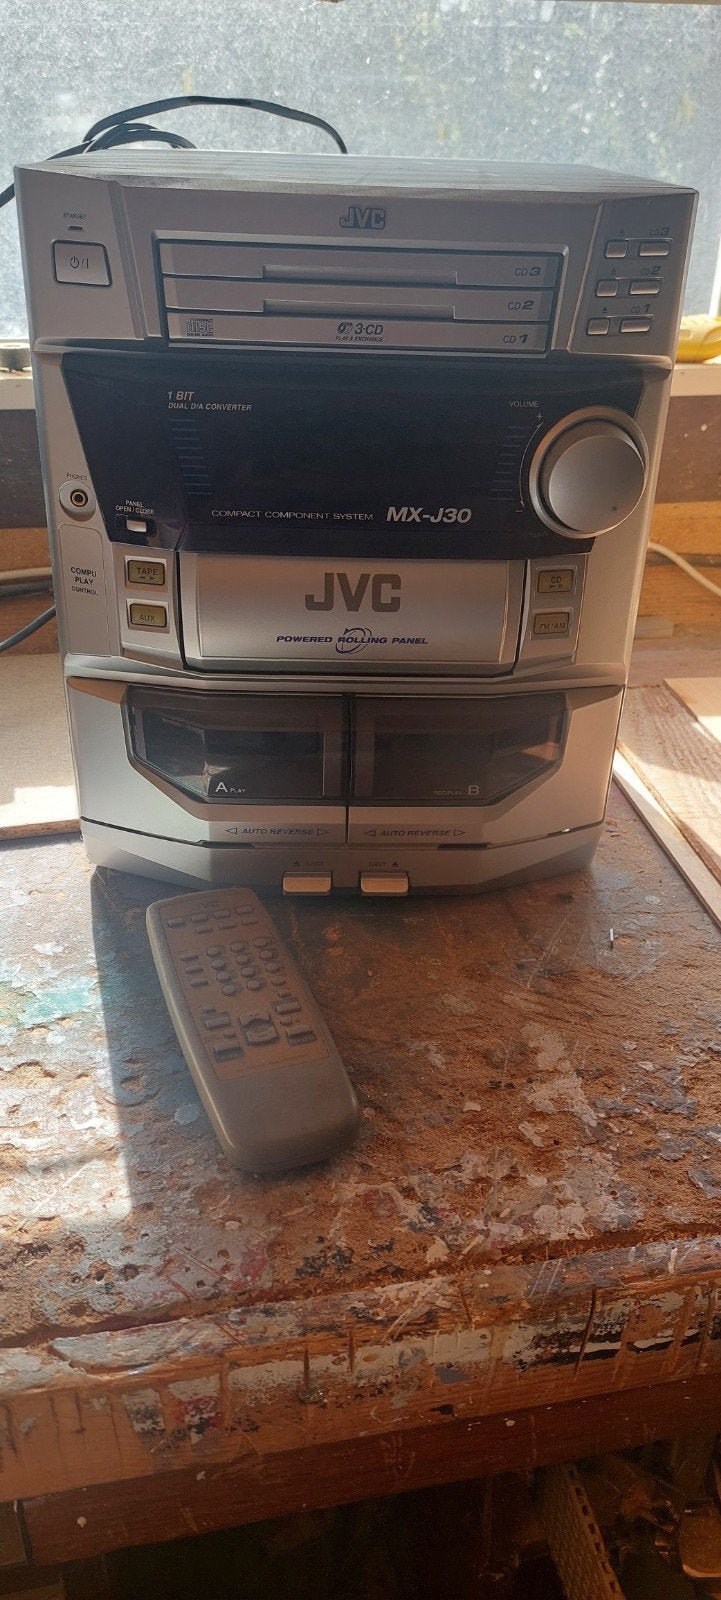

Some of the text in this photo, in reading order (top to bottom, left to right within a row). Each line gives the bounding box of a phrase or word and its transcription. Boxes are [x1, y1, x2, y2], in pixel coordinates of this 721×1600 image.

[339, 206, 386, 229] JVC
[167, 391, 195, 401] 1 BIT
[168, 402, 253, 411] DUAL D/A CONVERTER
[509, 400, 539, 408] VOLUME
[66, 472, 88, 482] PHONES
[125, 499, 144, 508] PANEL
[211, 509, 374, 521] COMPACT COMPONENT SYSTEM
[386, 506, 473, 523] MX-J30
[70, 566, 97, 577] COMPU
[136, 566, 158, 576] TAPE
[75, 577, 94, 586] PLAY
[551, 576, 562, 584] CD
[71, 585, 99, 596] CONTROL
[305, 572, 401, 613] JVC
[139, 613, 155, 622] AUX
[276, 635, 428, 645] POWERED ROLLING PANEL
[215, 781, 228, 793] A
[468, 784, 480, 796] B
[241, 828, 314, 836] AUTO REVERSE
[380, 829, 450, 838] AUTO REVERSE
